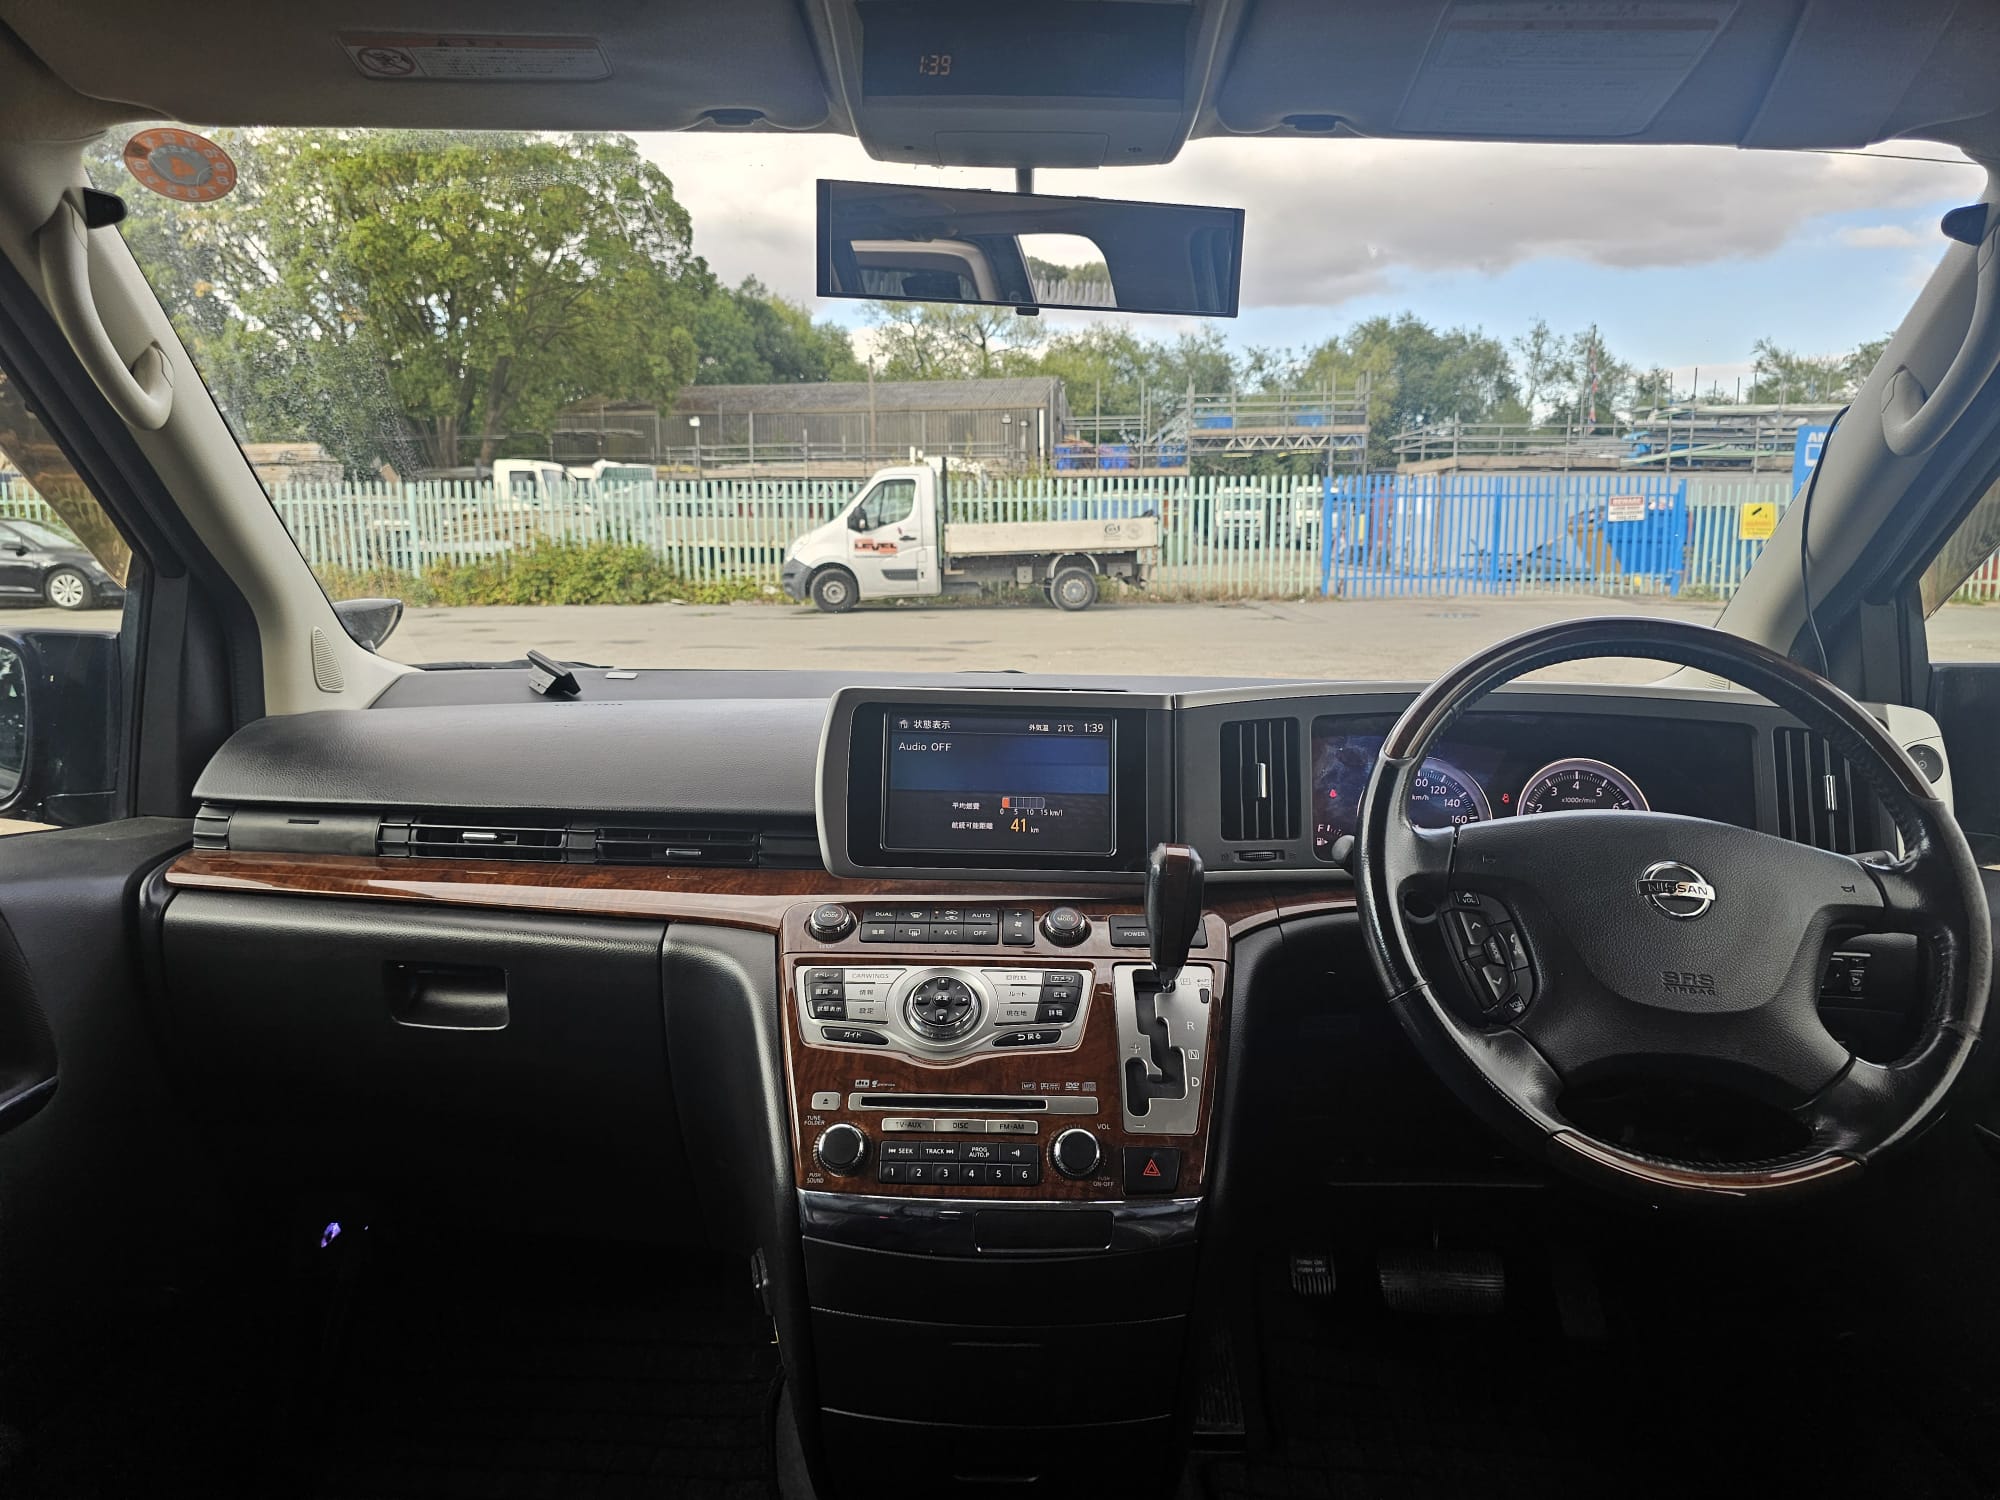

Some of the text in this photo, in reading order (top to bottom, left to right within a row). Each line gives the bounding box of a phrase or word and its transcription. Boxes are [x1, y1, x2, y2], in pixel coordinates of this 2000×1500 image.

[919, 54, 952, 76] 1:39
[855, 543, 897, 551] LEVEL
[913, 720, 951, 729] 状態表示
[1083, 723, 1104, 733] 1:39
[899, 742, 952, 751] Audio OFF
[1415, 778, 1429, 787] 00
[1572, 781, 1580, 790] 4
[1430, 785, 1447, 795] 120
[1551, 787, 1558, 796] 3
[1596, 787, 1603, 797] 5
[1411, 793, 1430, 801] km/h
[1444, 798, 1461, 808] 140
[1536, 804, 1543, 813] 2
[1451, 814, 1468, 824] 160
[1010, 818, 1027, 833] 41
[1317, 824, 1324, 832] F
[1647, 882, 1709, 896] NISSAN
[1187, 1022, 1195, 1030] R
[1190, 1051, 1198, 1059] N
[1191, 1077, 1200, 1087] D
[890, 1168, 894, 1176] 1
[916, 1168, 922, 1177] 2
[943, 1169, 949, 1177] 3
[968, 1170, 975, 1178] 4
[996, 1170, 1001, 1178] 5
[1022, 1171, 1028, 1179] 6
